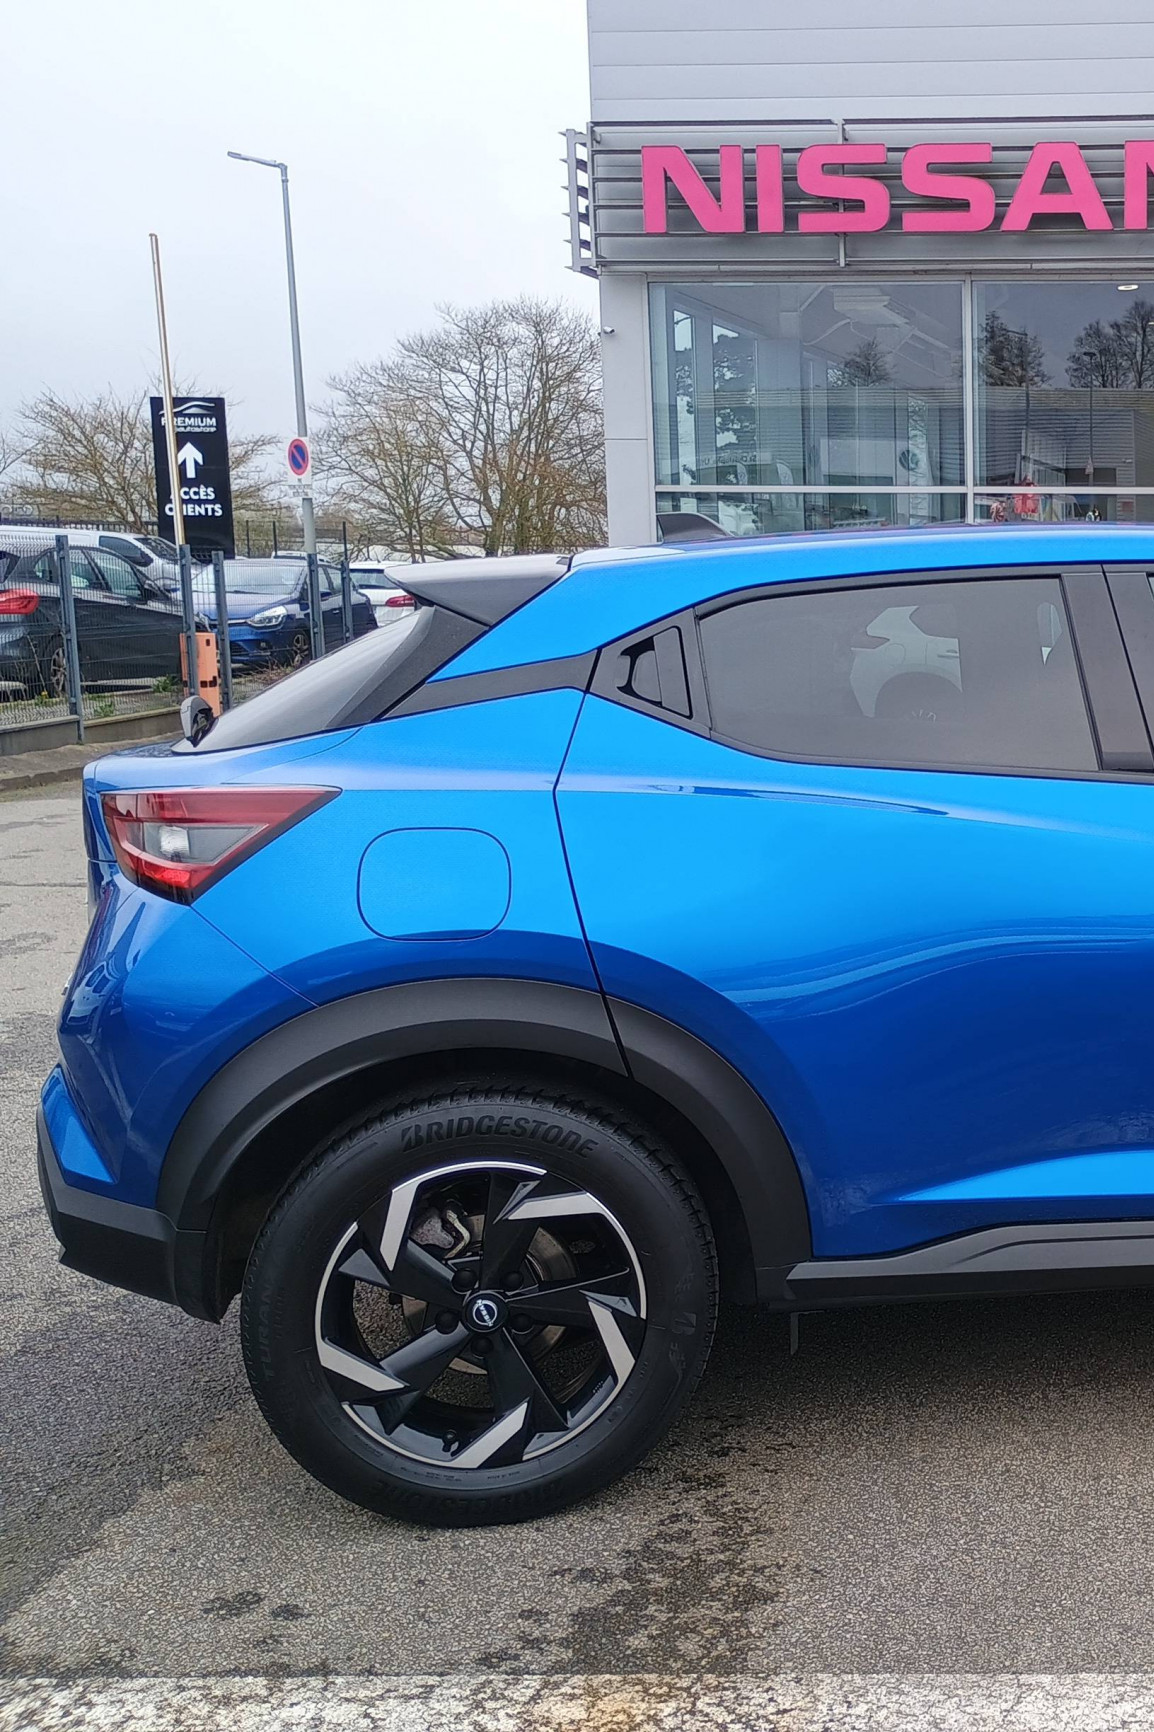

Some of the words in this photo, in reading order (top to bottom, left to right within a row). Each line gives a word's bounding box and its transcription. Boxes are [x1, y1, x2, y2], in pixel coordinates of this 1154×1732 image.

[170, 484, 216, 500] CCÈS
[164, 503, 223, 516] CIENTS
[400, 1114, 599, 1159] BRIDGESTONE
